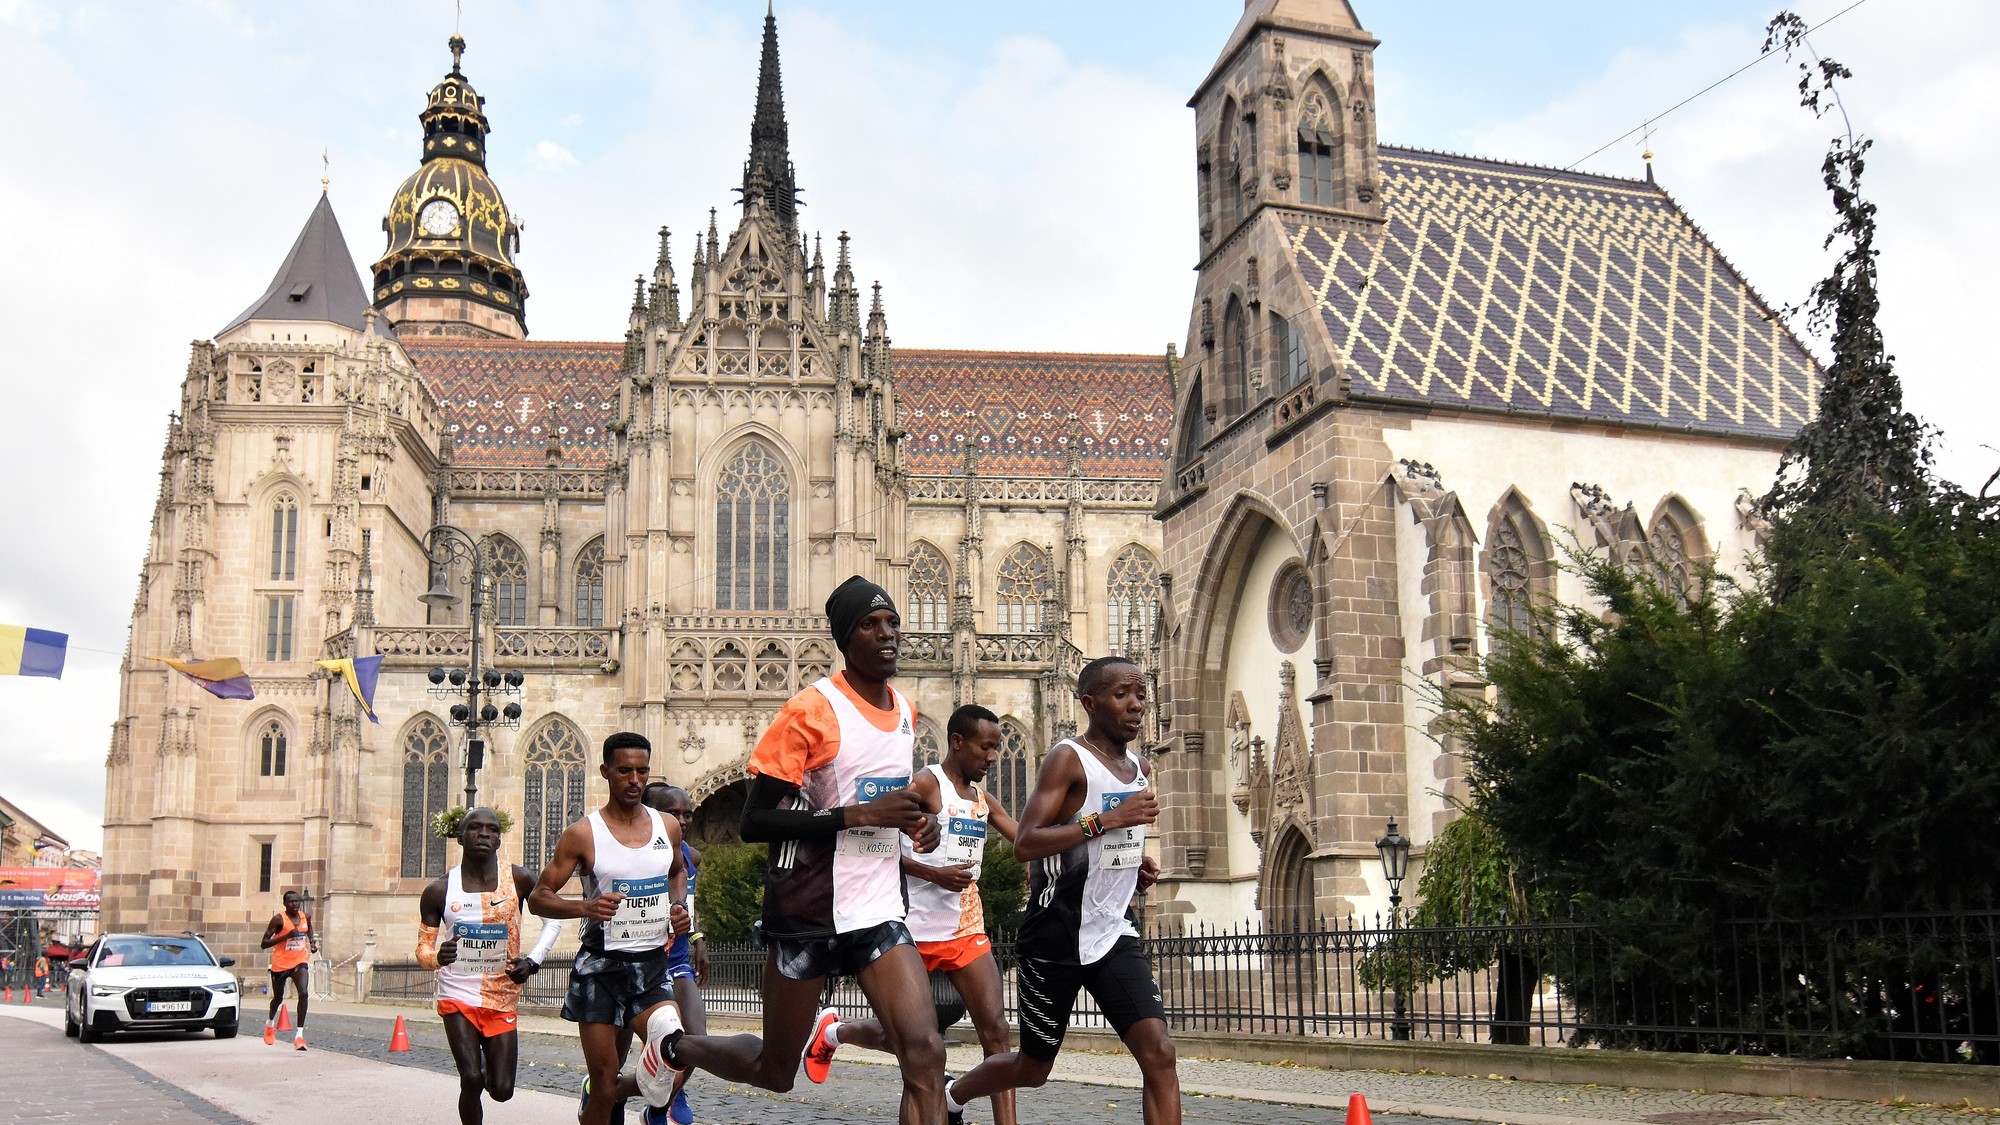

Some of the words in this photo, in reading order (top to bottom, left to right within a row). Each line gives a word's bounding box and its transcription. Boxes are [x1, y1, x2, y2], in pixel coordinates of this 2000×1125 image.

[1127, 830, 1133, 840] 15
[958, 836, 979, 848] SHUMET
[866, 842, 893, 853] KOŠICE
[968, 849, 972, 857] 3
[626, 896, 659, 908] TUEMAY
[463, 939, 497, 949] HILLARY
